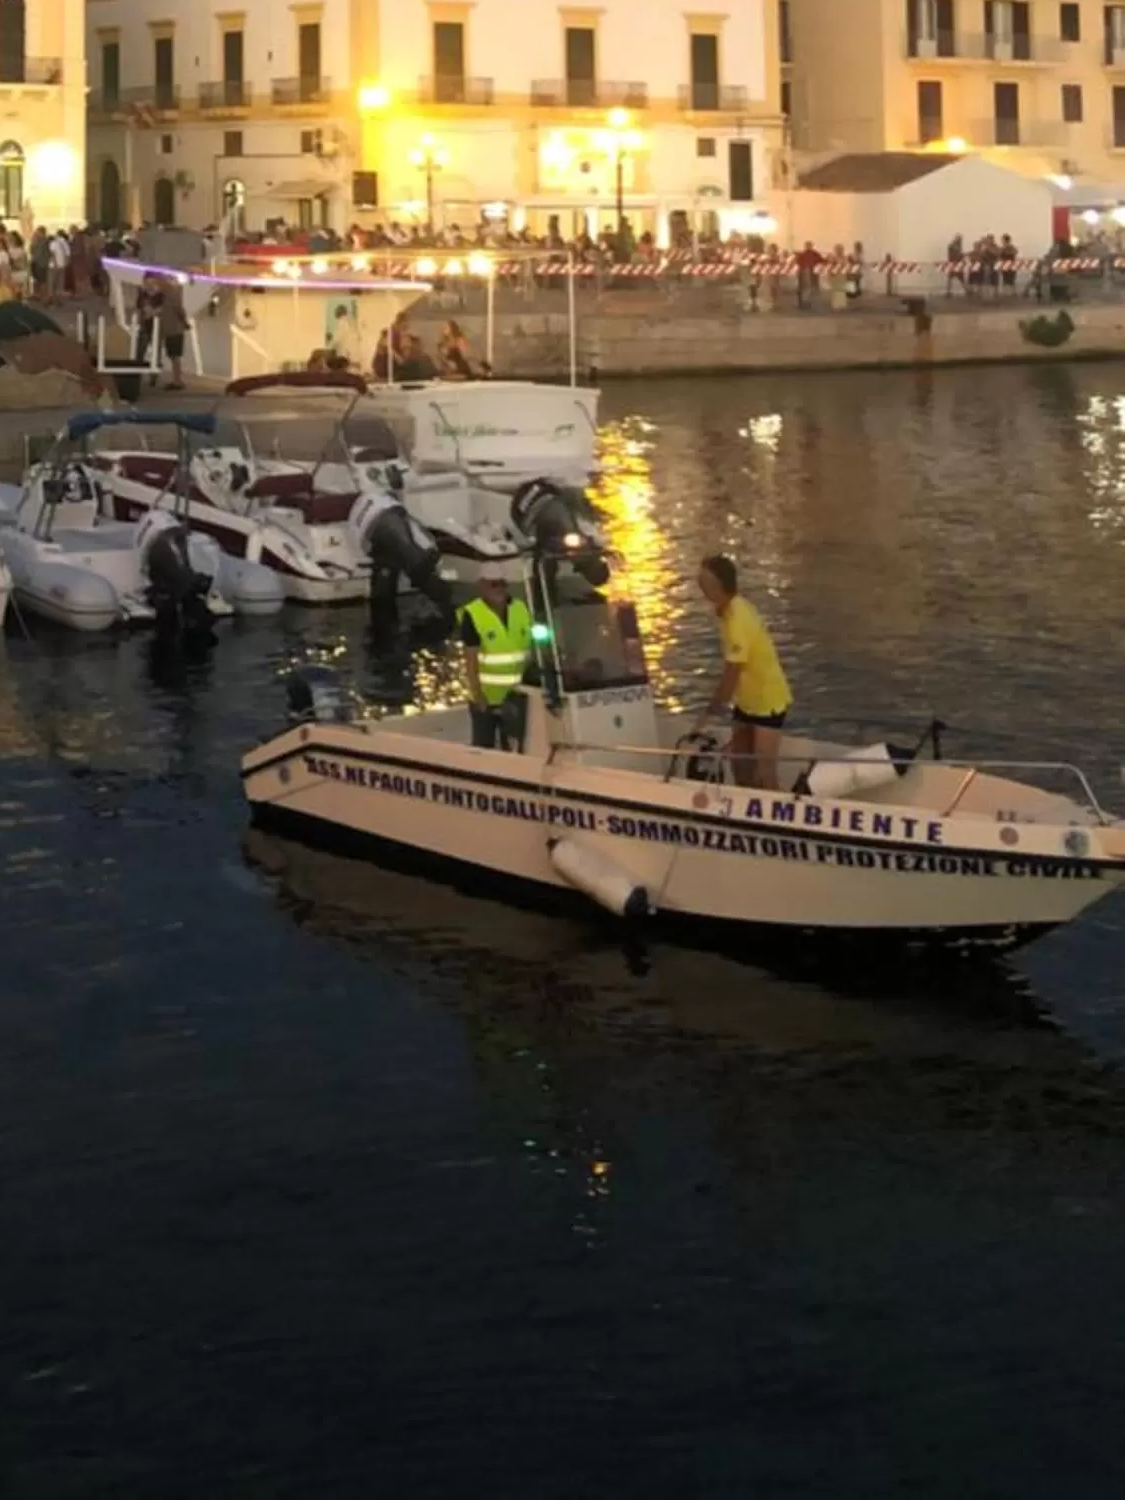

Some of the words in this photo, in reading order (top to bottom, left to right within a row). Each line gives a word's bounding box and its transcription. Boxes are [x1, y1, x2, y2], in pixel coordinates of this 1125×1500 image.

[369, 770, 426, 799] PAOLO
[431, 782, 490, 813] PINTO
[491, 795, 596, 831] GALLIPOLI
[606, 814, 809, 861] SOMMOZZATORI
[816, 844, 999, 878] PROTEZIONE
[746, 798, 944, 843] AMBIENTE
